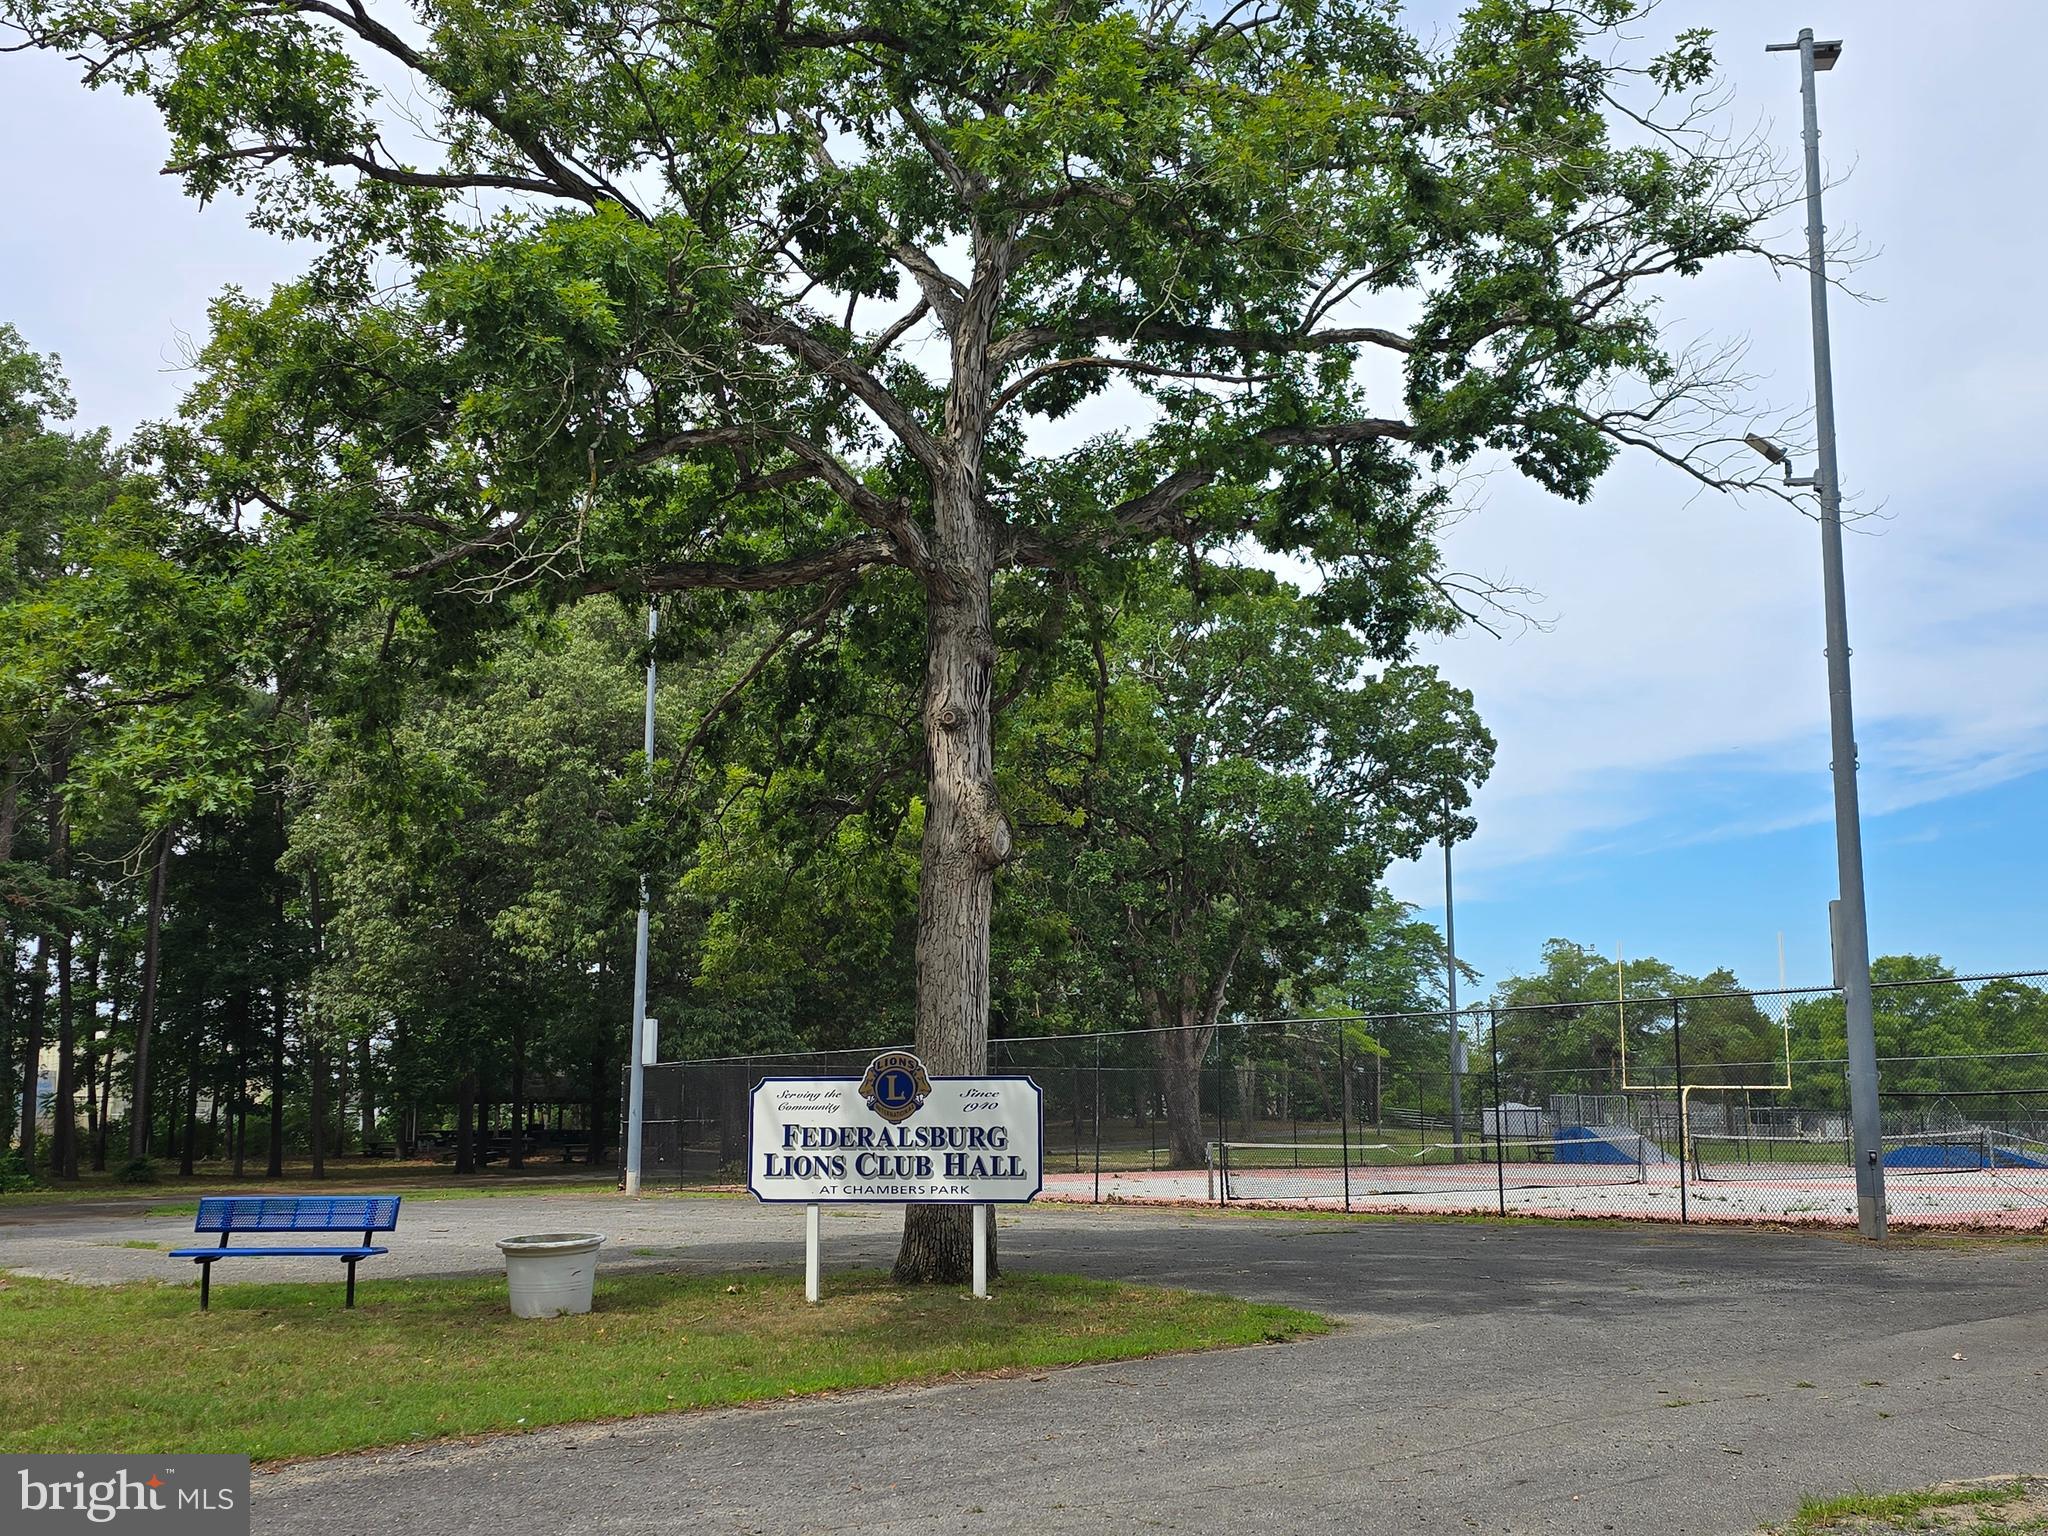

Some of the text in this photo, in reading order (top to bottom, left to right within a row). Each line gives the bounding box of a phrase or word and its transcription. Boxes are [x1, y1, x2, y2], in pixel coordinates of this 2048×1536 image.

[876, 1057, 915, 1070] LIONS
[885, 1075, 906, 1100] L
[960, 1088, 1000, 1098] Since
[776, 1089, 842, 1101] Serving the
[778, 1102, 840, 1113] Community
[962, 1102, 999, 1112] 1940
[781, 1124, 1009, 1150] FEDERALSBURG
[763, 1152, 1028, 1179] LIONS CLUB HALL
[819, 1185, 970, 1195] AT CHAMBERS PARK
